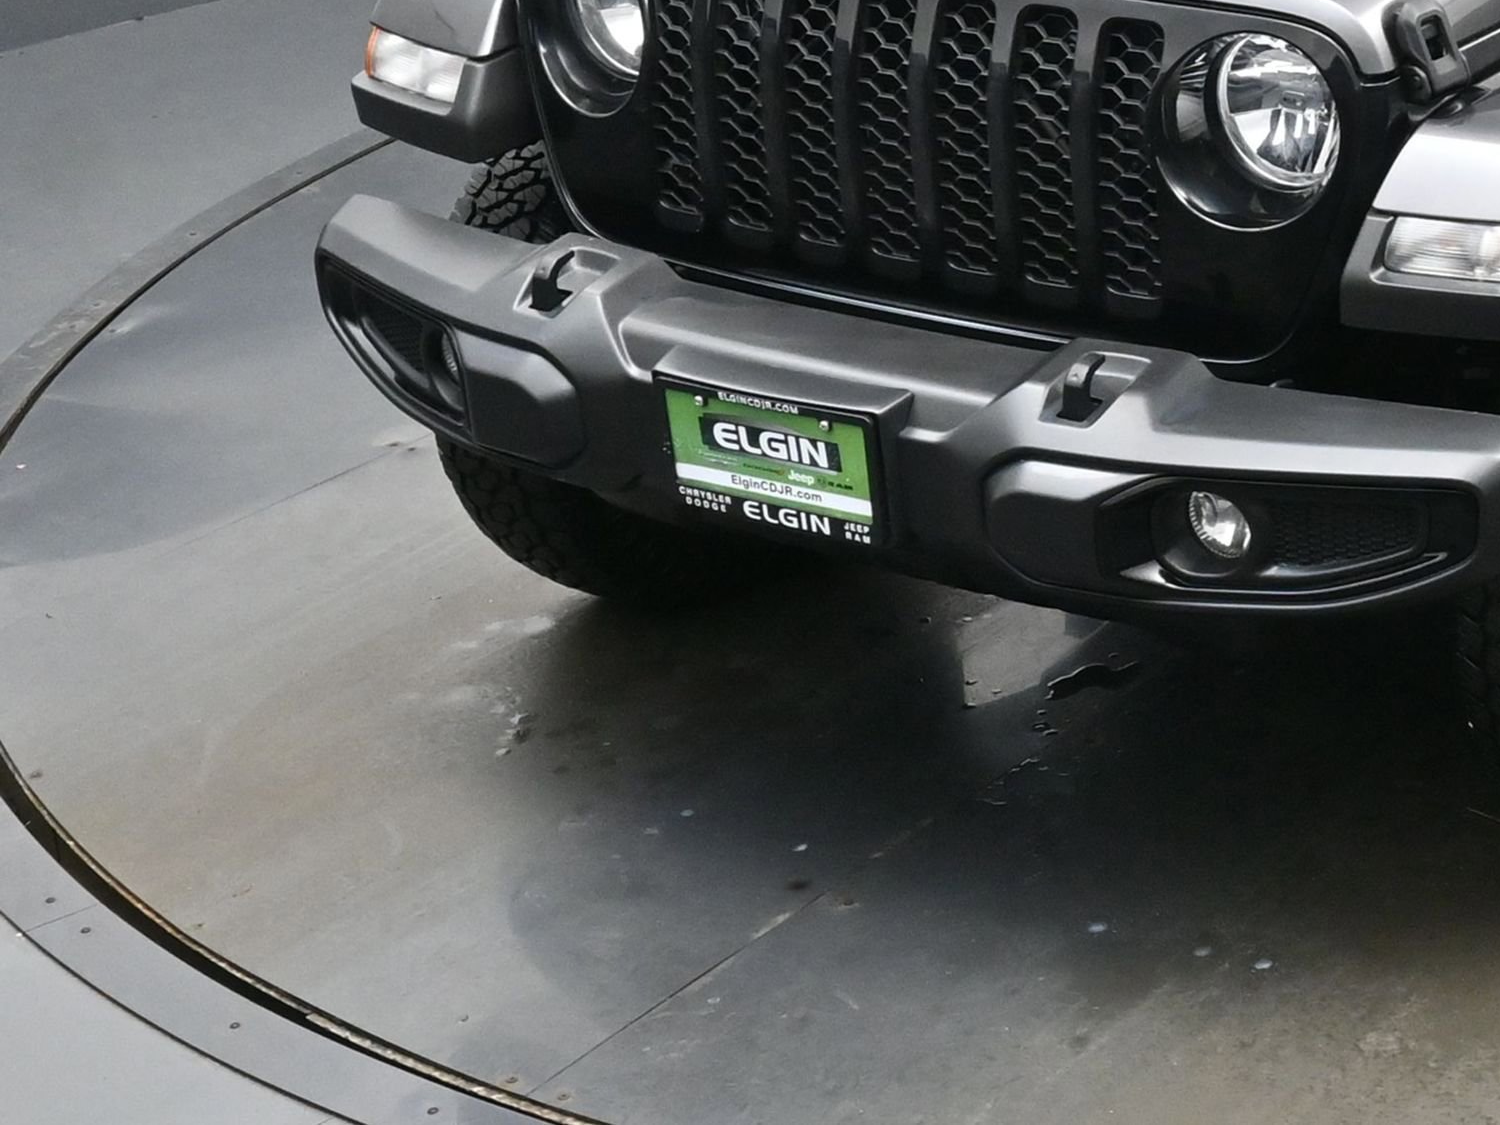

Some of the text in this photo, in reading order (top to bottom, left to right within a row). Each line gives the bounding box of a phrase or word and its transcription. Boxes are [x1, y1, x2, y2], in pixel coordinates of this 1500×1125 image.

[712, 421, 830, 469] ELGIN
[788, 469, 815, 486] Jeep
[678, 485, 733, 506] CHRYSLER
[730, 473, 823, 503] ElginCDJR.com
[685, 496, 727, 513] DODGE
[742, 500, 831, 536] ELGIN
[843, 522, 870, 534] JEEP
[844, 531, 871, 545] RAM
